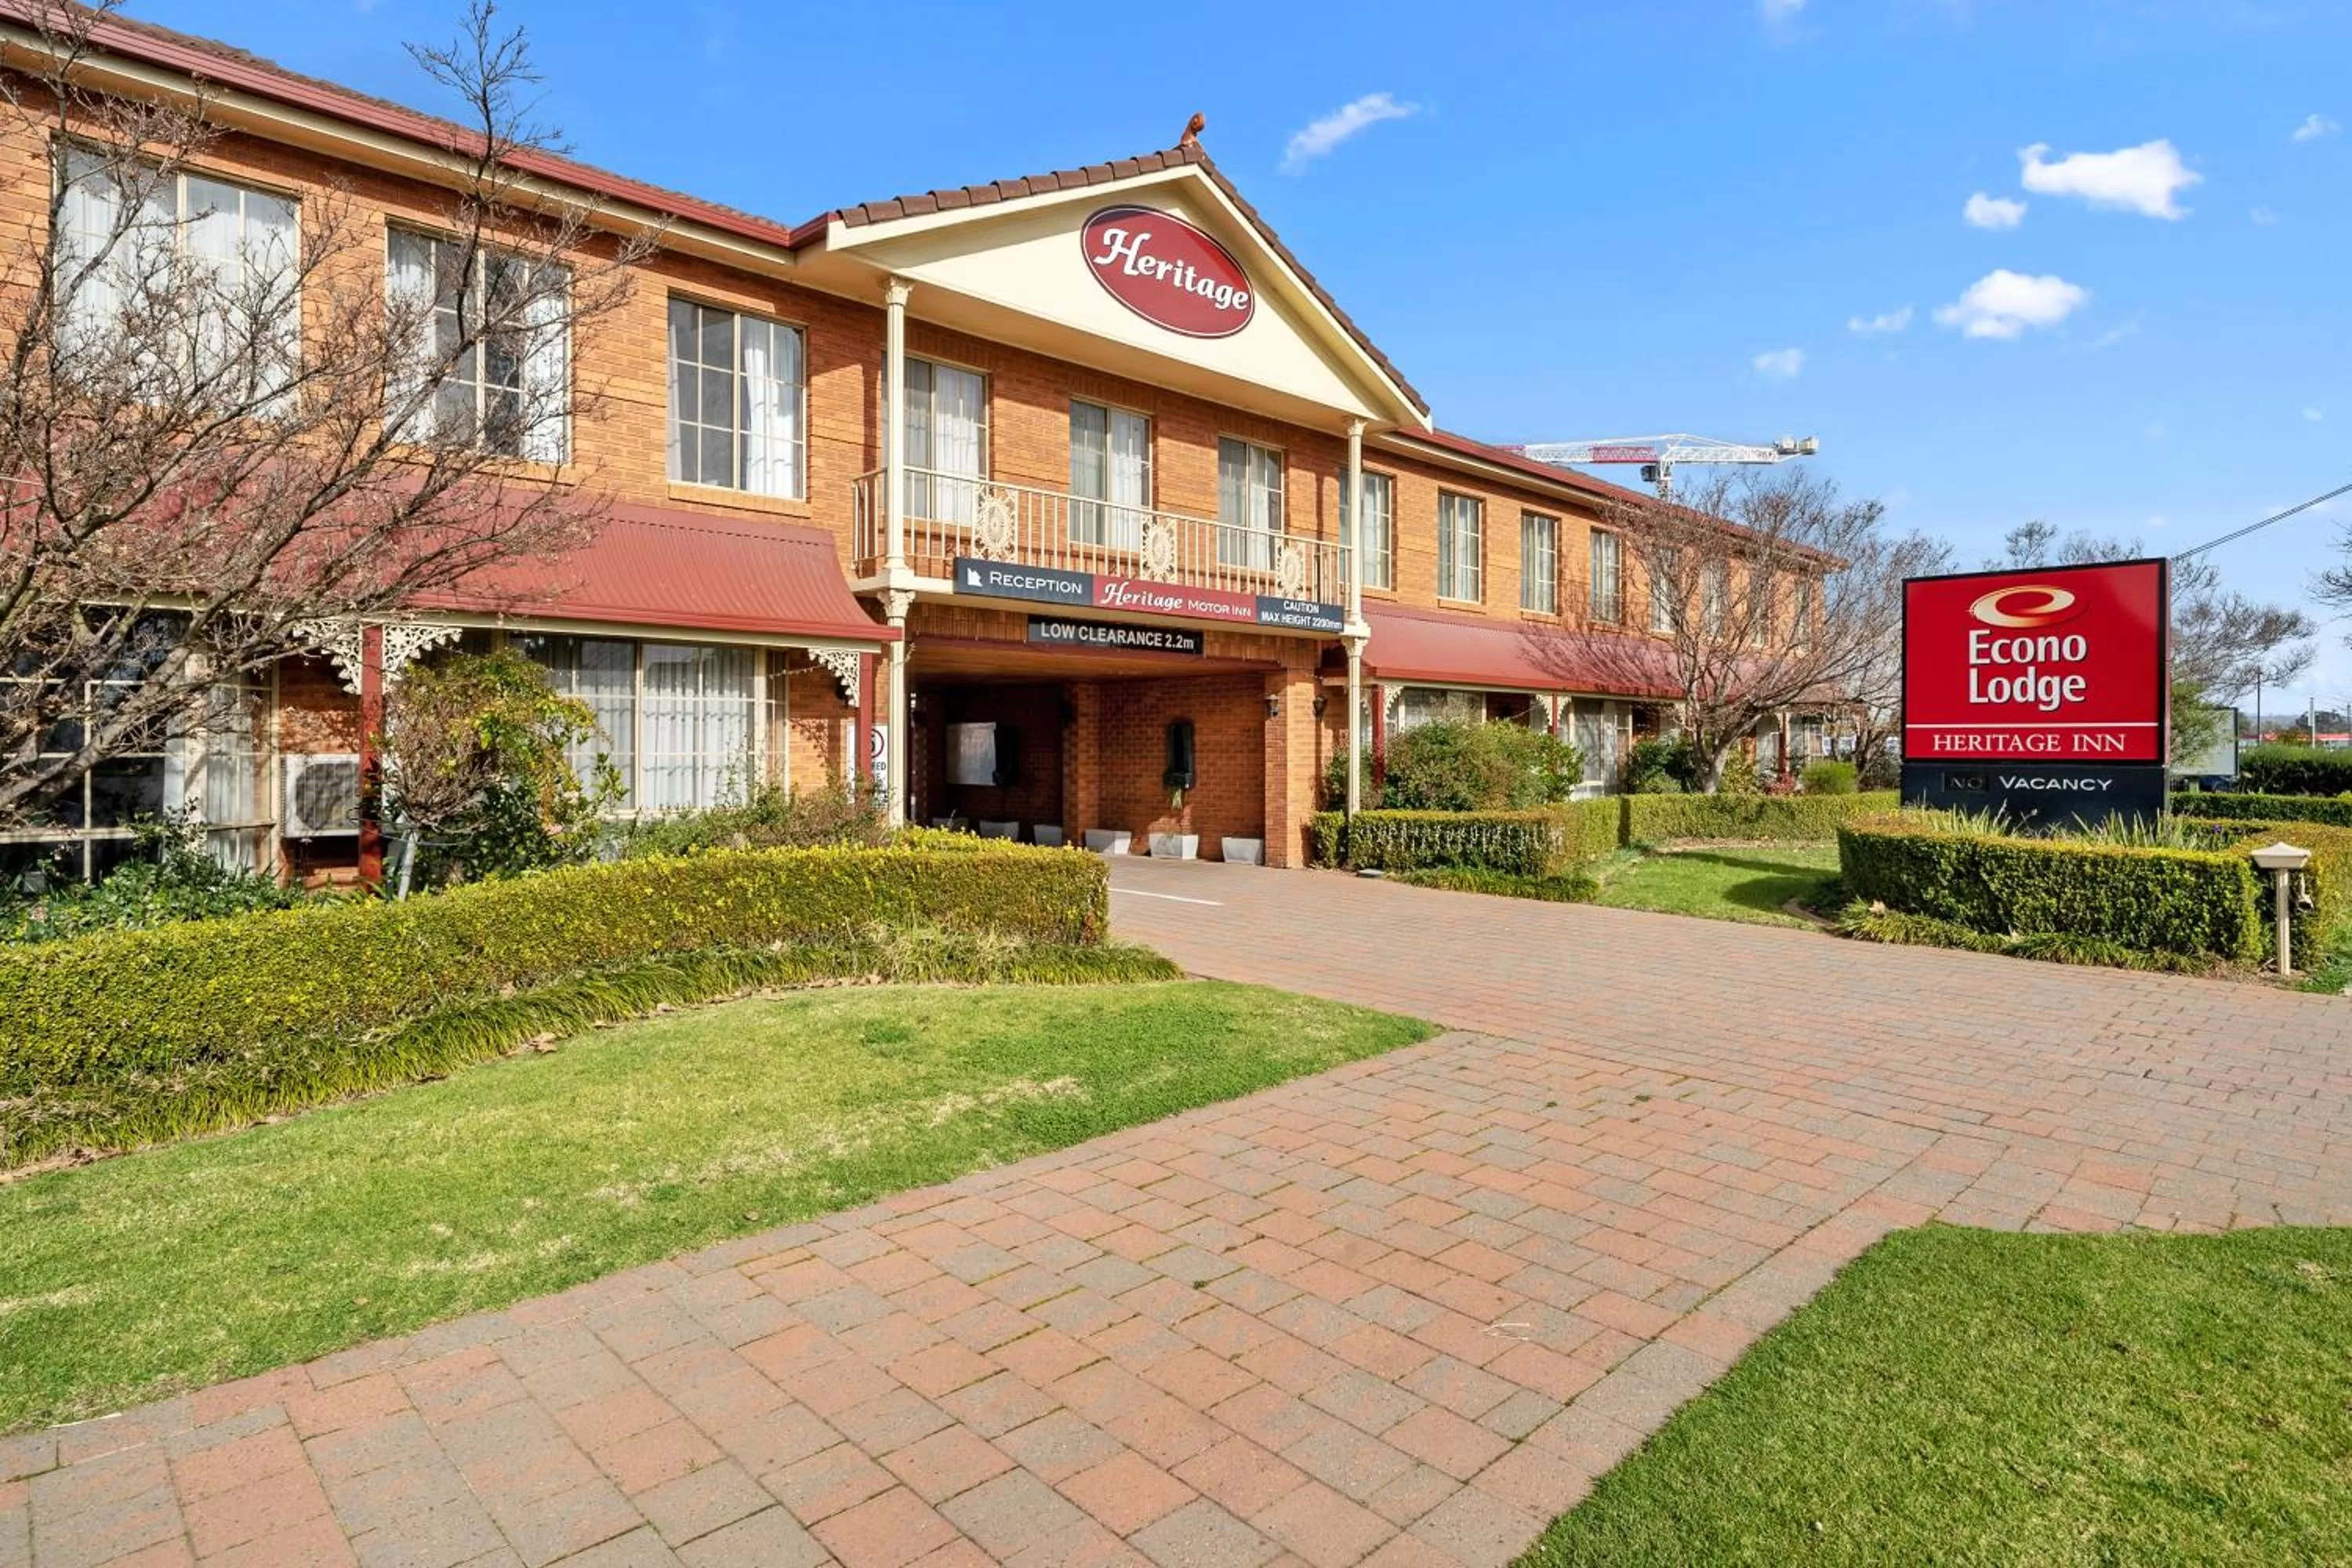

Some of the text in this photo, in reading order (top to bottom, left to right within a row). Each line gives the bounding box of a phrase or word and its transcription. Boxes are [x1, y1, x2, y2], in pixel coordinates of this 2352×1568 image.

[1094, 227, 1249, 310] Heritage
[989, 571, 1083, 594] RECEPTION
[1100, 582, 1251, 617] Heritage MOTOR INN
[1283, 601, 1319, 614] CAUTION
[1261, 611, 1280, 622] MAX
[1282, 614, 1311, 626] HEIGHT
[1041, 622, 1195, 649] LOW CLEARANCE 2.2m
[1969, 629, 2087, 665] Econo
[1969, 666, 2086, 711] Lodge
[1933, 734, 2126, 752] HERITAGE INN
[1998, 775, 2113, 791] VACANCY
